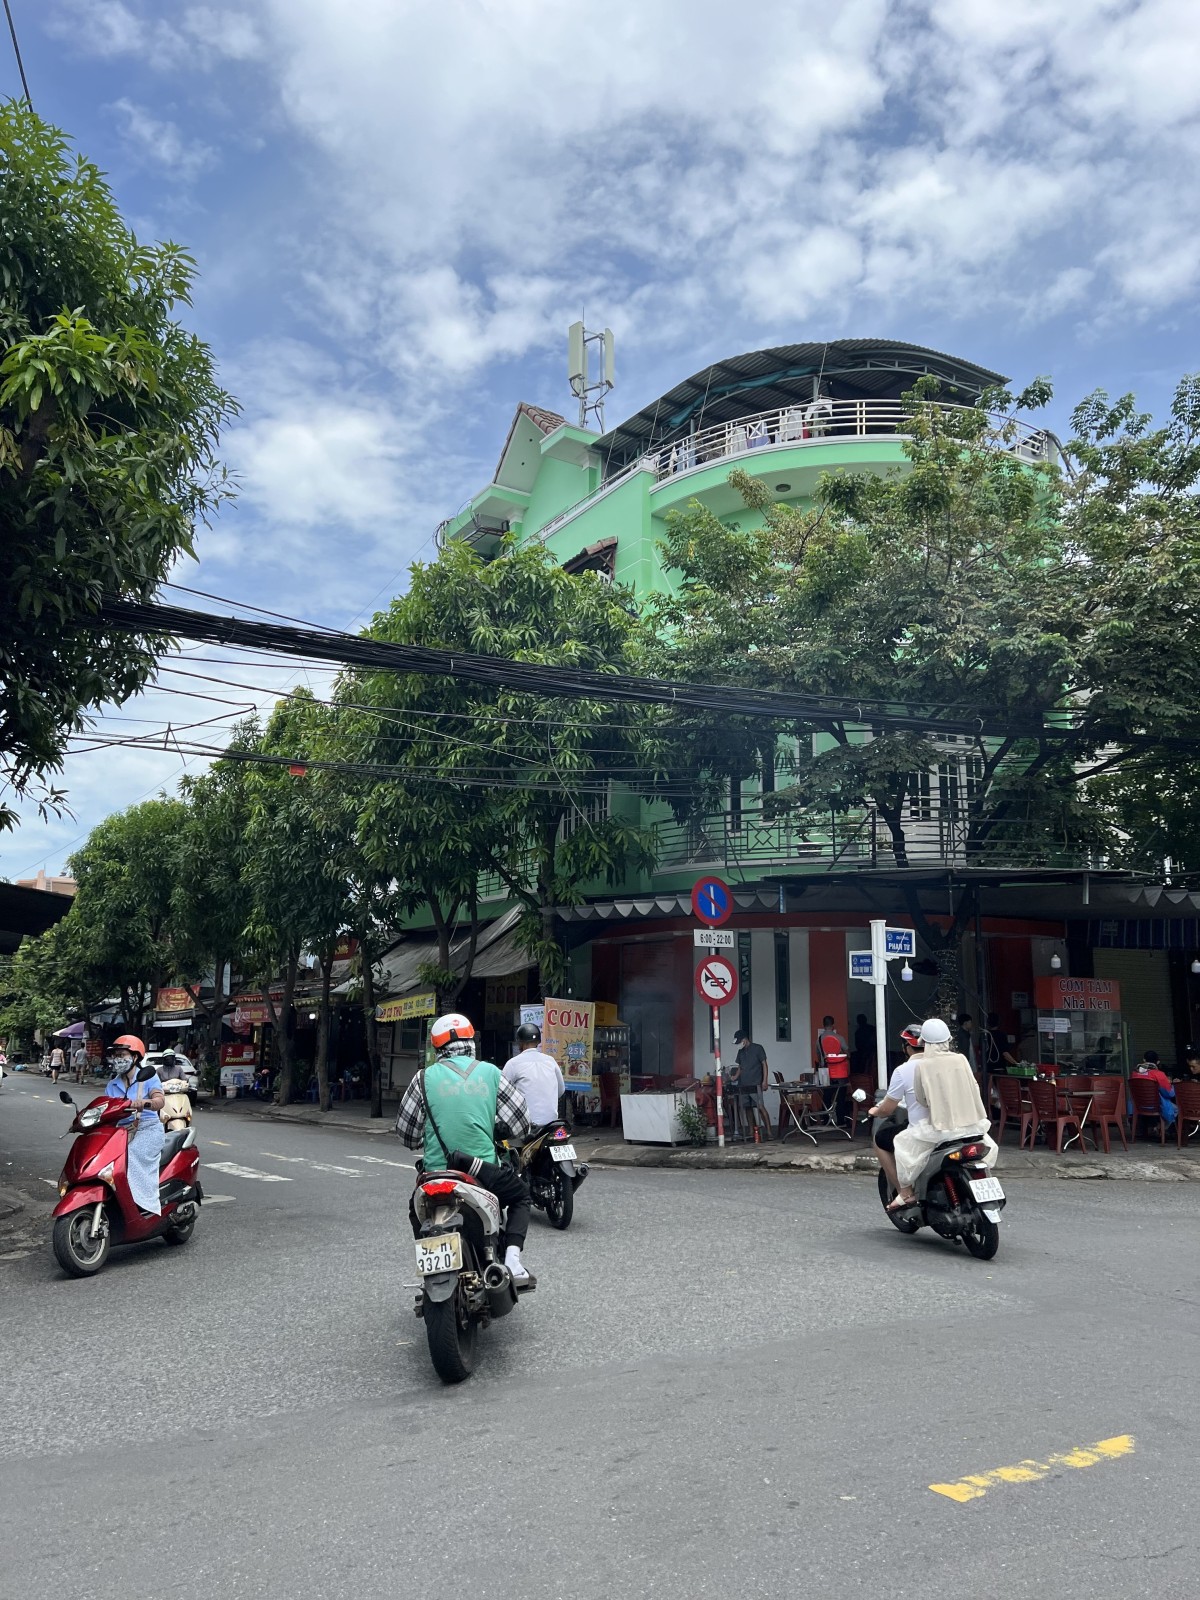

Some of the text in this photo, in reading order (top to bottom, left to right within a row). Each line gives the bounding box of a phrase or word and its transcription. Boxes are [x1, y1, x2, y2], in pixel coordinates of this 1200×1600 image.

[1062, 993, 1111, 1010] Nhà Ken
[547, 1009, 590, 1028] CƠM
[568, 1047, 586, 1056] 25K
